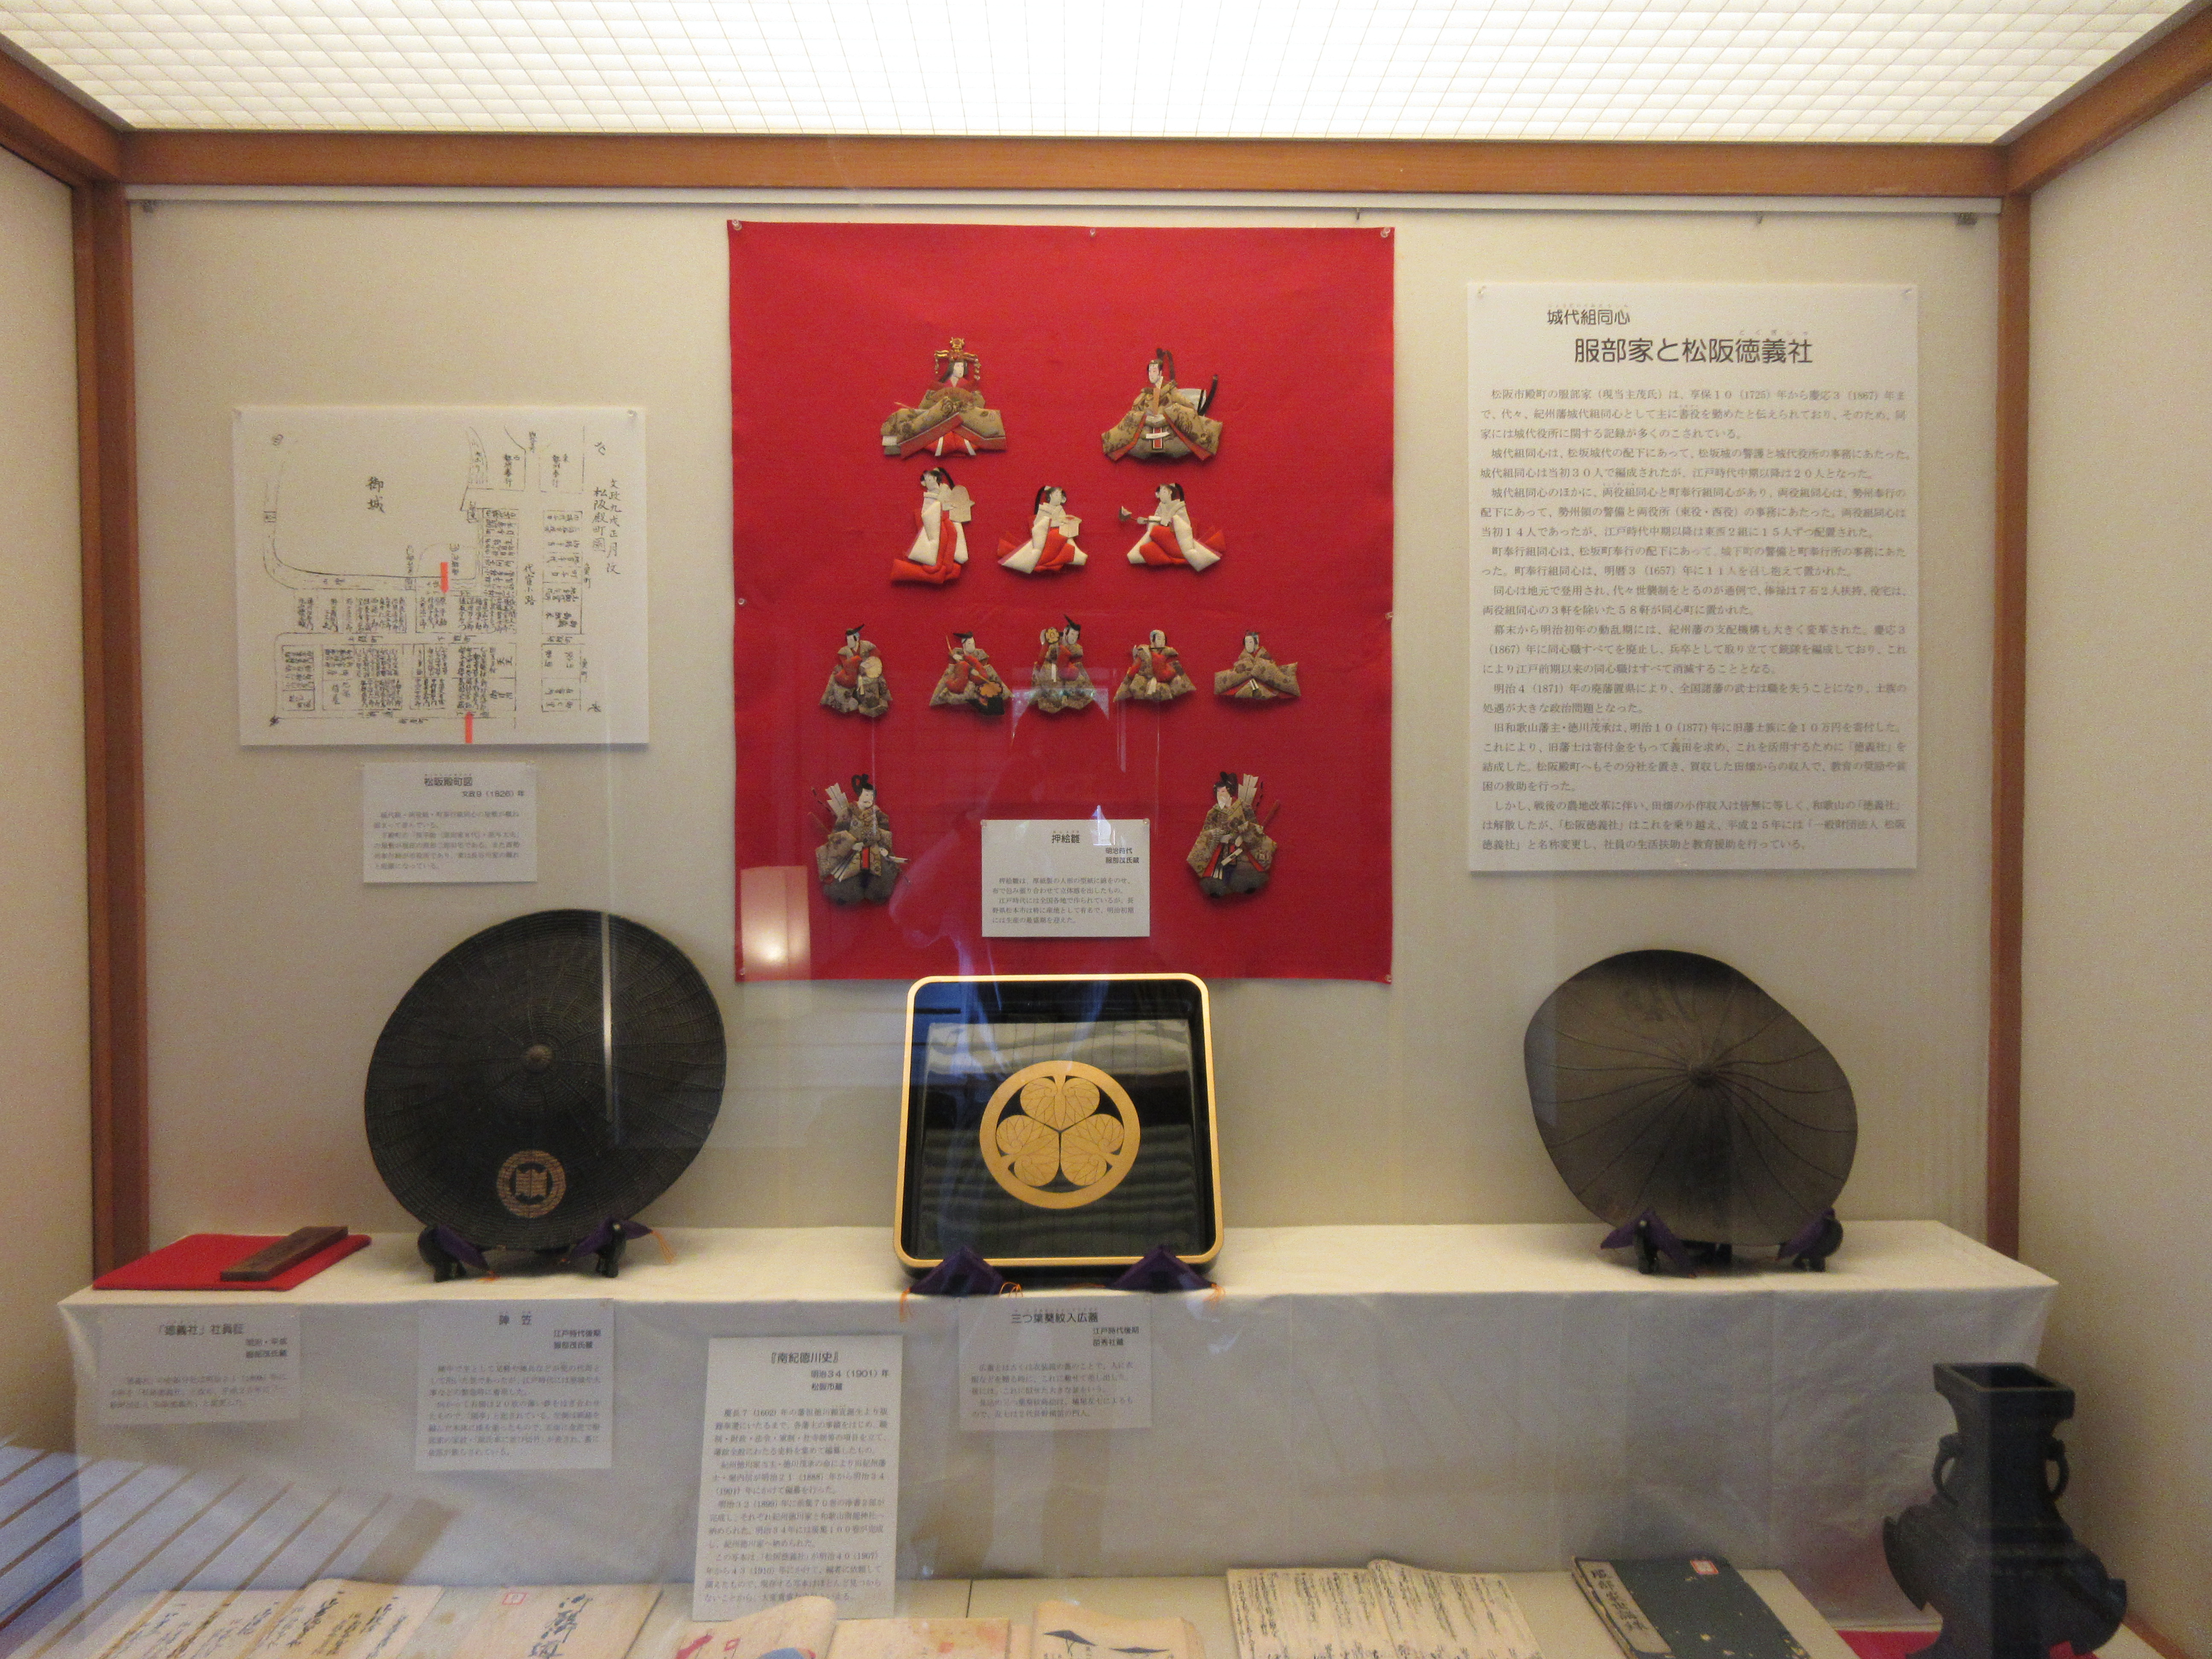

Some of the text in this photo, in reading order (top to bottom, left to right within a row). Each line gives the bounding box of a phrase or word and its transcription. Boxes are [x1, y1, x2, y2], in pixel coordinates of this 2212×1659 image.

[1547, 309, 1630, 325] 城代組同心
[1575, 338, 1813, 363] 服部家と松阪徳義社
[1481, 429, 1740, 438] 家には城代役所に関する記録が多くのこされている。
[594, 441, 606, 455] 北
[366, 476, 385, 513] 御城
[1483, 703, 1642, 713] 処遇が大きな政治問題となった。
[424, 777, 473, 786] 松阪殿町図
[1482, 782, 1576, 791] 困の救助を行った。
[1052, 834, 1080, 844] 押絵雛
